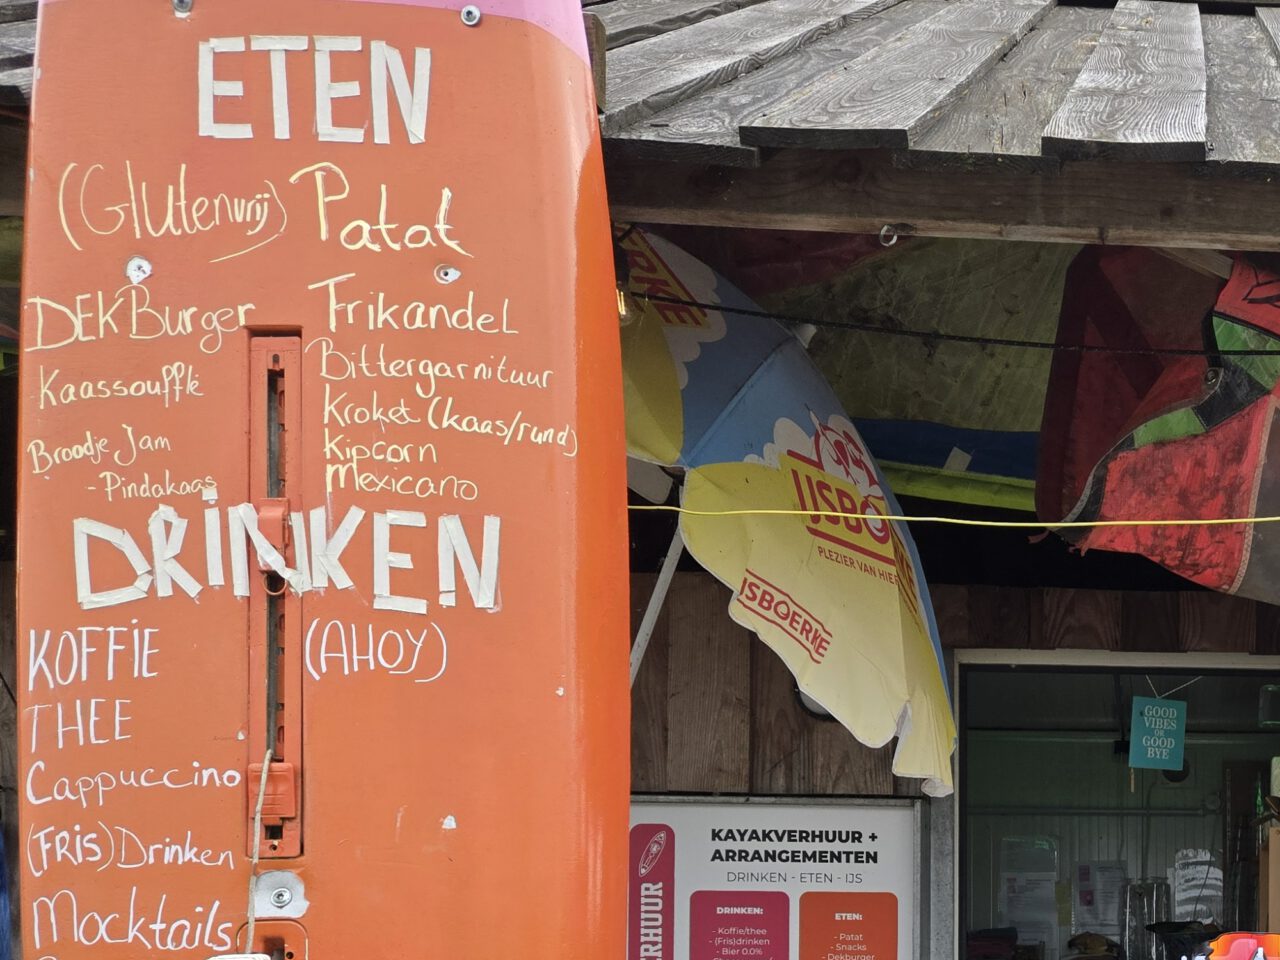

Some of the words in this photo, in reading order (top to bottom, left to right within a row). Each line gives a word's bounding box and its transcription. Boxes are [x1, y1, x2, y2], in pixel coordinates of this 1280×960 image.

[198, 35, 430, 145] ETEN
[289, 162, 474, 258] Patat
[323, 384, 421, 432] Kroket
[27, 431, 109, 474] Broodje
[114, 424, 171, 466] Jam
[325, 462, 478, 500] Mexicano
[817, 545, 856, 570] PLEZIER
[857, 559, 877, 578] VAN
[304, 619, 447, 682] (AHOY)
[1144, 705, 1177, 718] GOOD
[24, 699, 132, 753] THEE
[1144, 717, 1177, 730] VIBES
[1154, 729, 1165, 737] OR
[1142, 736, 1175, 749] GOOD
[1146, 747, 1169, 760] BYE
[27, 760, 241, 806] Cappuccino
[711, 828, 863, 844] KAYAKVERHUUR
[115, 826, 235, 869] Drinken
[710, 848, 879, 864] ARRANGEMENTEN
[726, 872, 788, 883] DRINKEN
[799, 873, 833, 883] ETEN
[845, 874, 863, 883] IJS
[33, 886, 233, 950] Mocktails
[716, 906, 764, 915] DRINKEN:
[834, 913, 863, 921] ETEN:
[718, 926, 767, 935] Koffie/thee
[839, 933, 863, 941] Patat
[722, 947, 739, 956] Bier
[835, 943, 867, 951] Snacks
